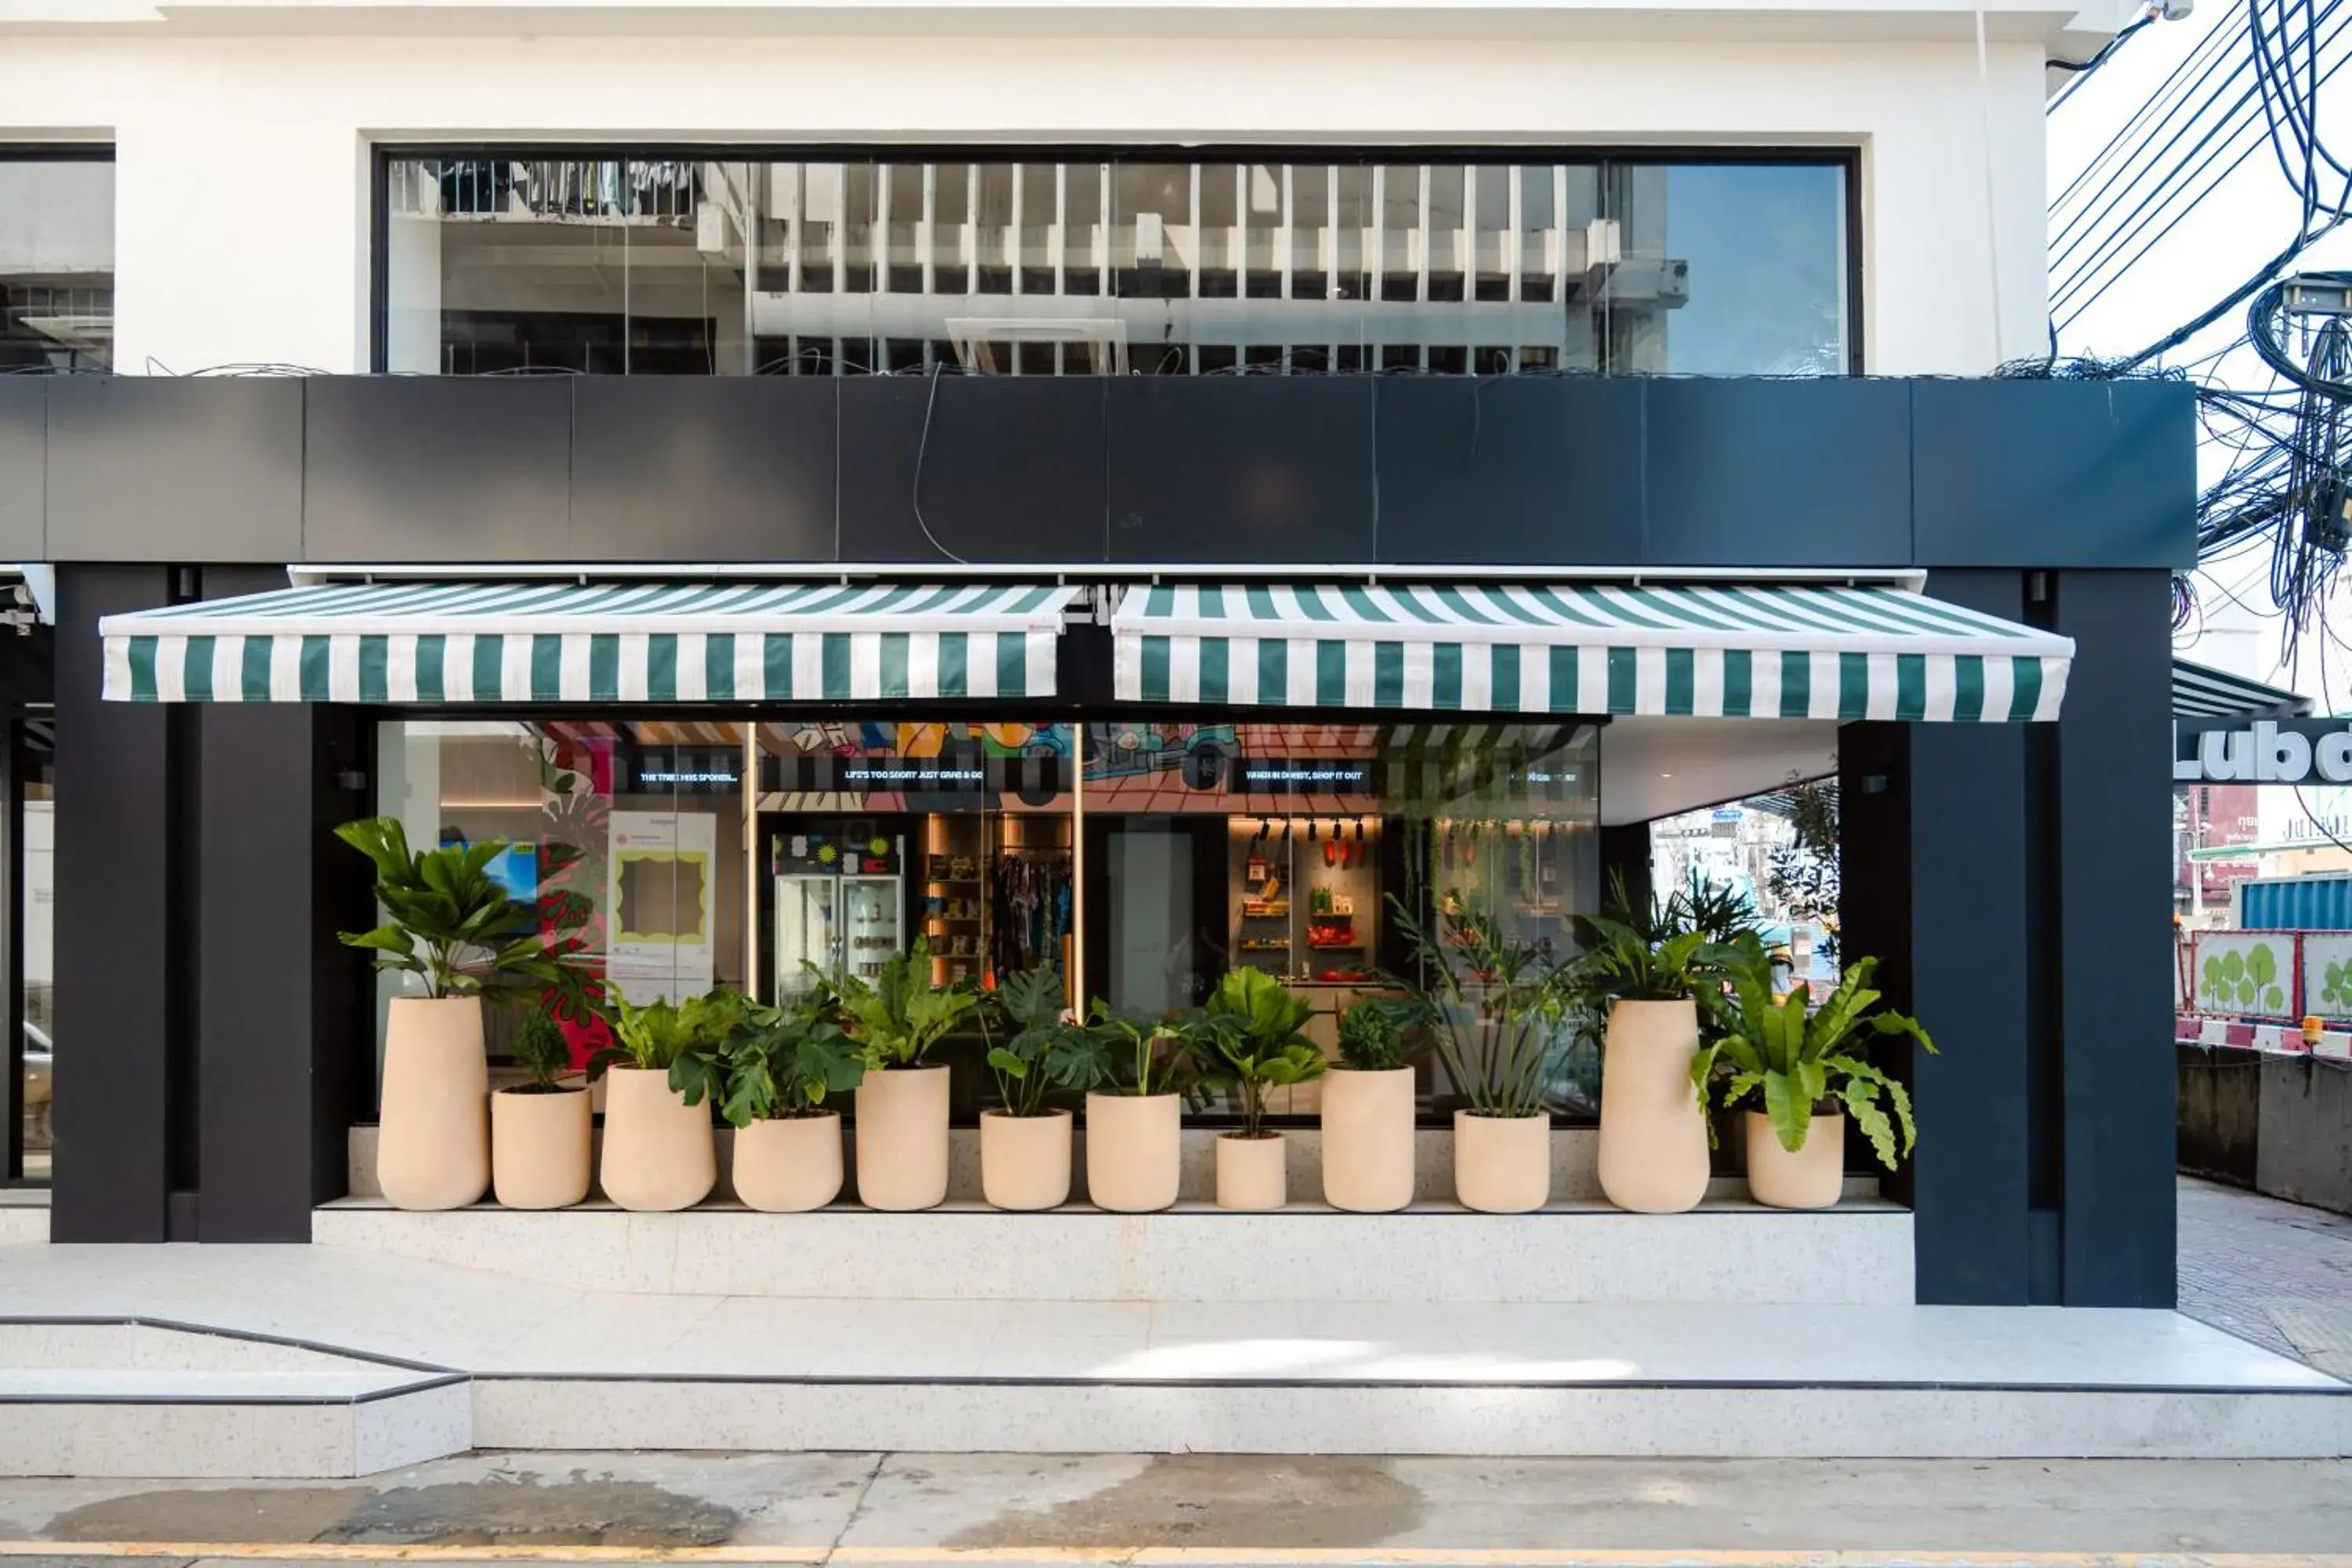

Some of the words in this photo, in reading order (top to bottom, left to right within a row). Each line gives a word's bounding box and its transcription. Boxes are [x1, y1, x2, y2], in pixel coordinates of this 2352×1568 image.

[641, 773, 657, 782] THE
[1336, 771, 1344, 780] IT
[1345, 771, 1363, 780] OUT
